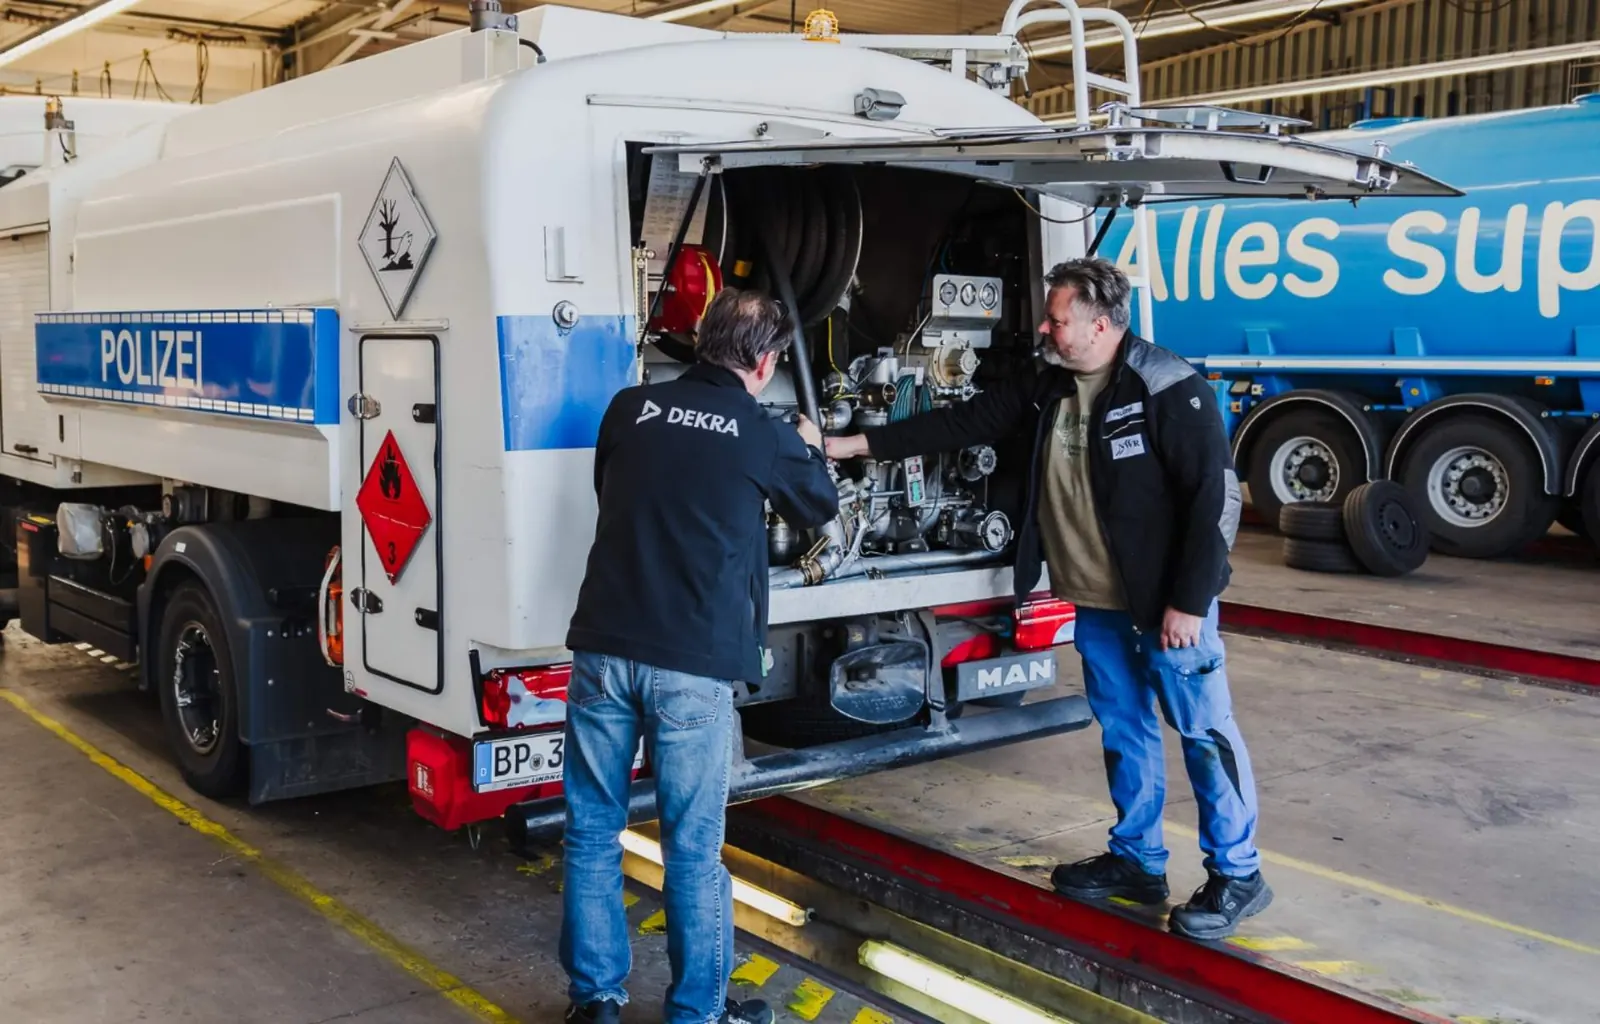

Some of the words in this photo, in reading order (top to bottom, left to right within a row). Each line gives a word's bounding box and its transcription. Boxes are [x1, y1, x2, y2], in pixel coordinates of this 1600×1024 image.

[1116, 203, 1341, 302] Alles
[1383, 199, 1600, 318] sup
[101, 329, 204, 394] POLIZEI
[667, 406, 739, 437] DEKRA
[388, 541, 396, 565] 3
[978, 659, 1052, 690] MAN
[494, 743, 530, 777] BP
